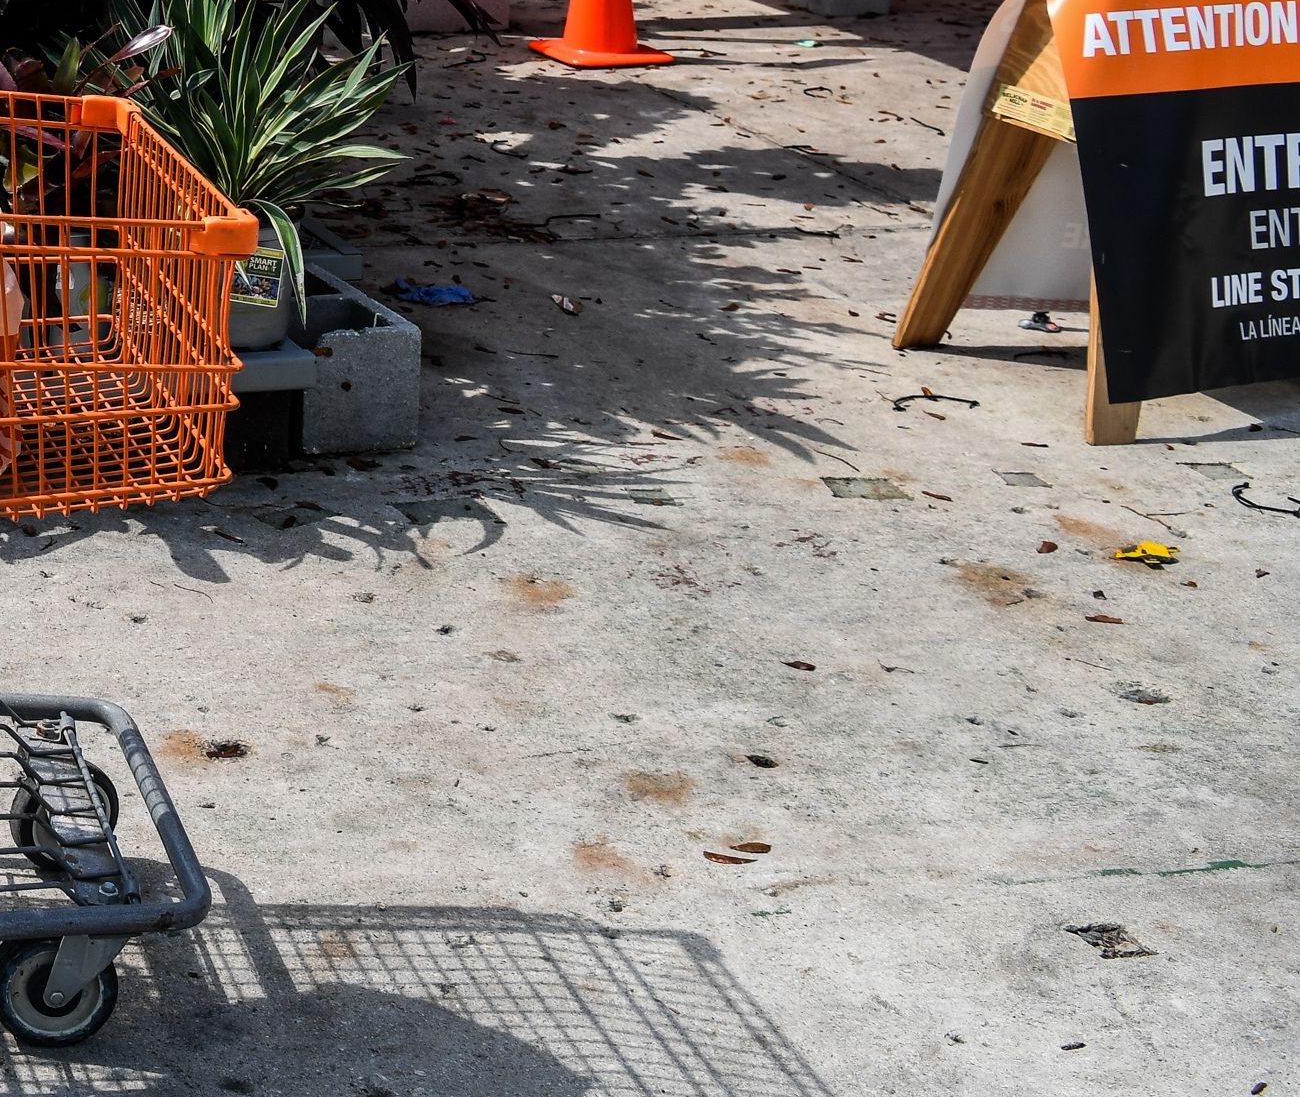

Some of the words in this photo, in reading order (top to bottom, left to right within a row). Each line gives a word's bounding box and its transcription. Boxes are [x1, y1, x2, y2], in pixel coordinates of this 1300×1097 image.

[1083, 1, 1299, 58] ATTENTION
[250, 256, 277, 266] SMART
[1211, 272, 1264, 308] LINE
[1239, 320, 1258, 341] LA
